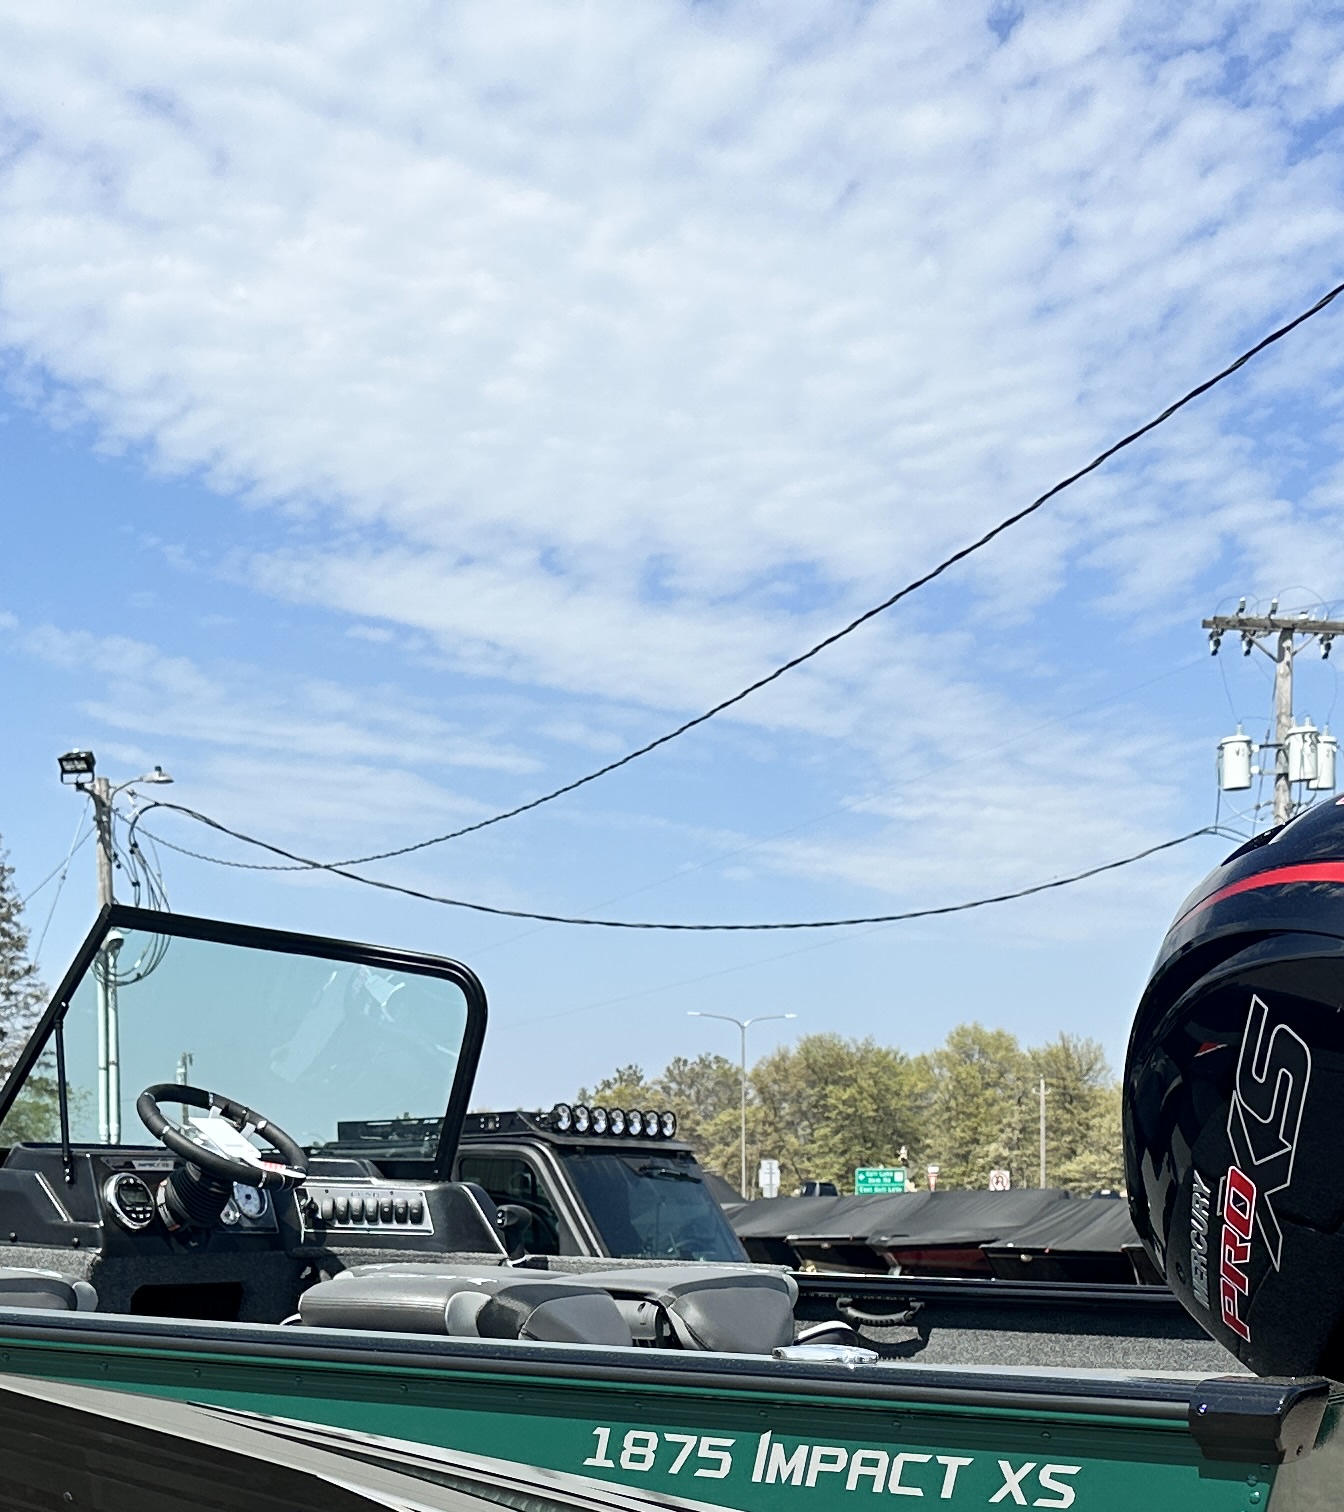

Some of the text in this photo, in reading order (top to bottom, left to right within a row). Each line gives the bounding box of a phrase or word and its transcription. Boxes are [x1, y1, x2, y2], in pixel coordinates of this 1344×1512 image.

[1219, 993, 1312, 1344] PRO XS
[1189, 1169, 1213, 1309] MERCURY
[582, 1426, 1083, 1510] 1875 IMPACT XS
